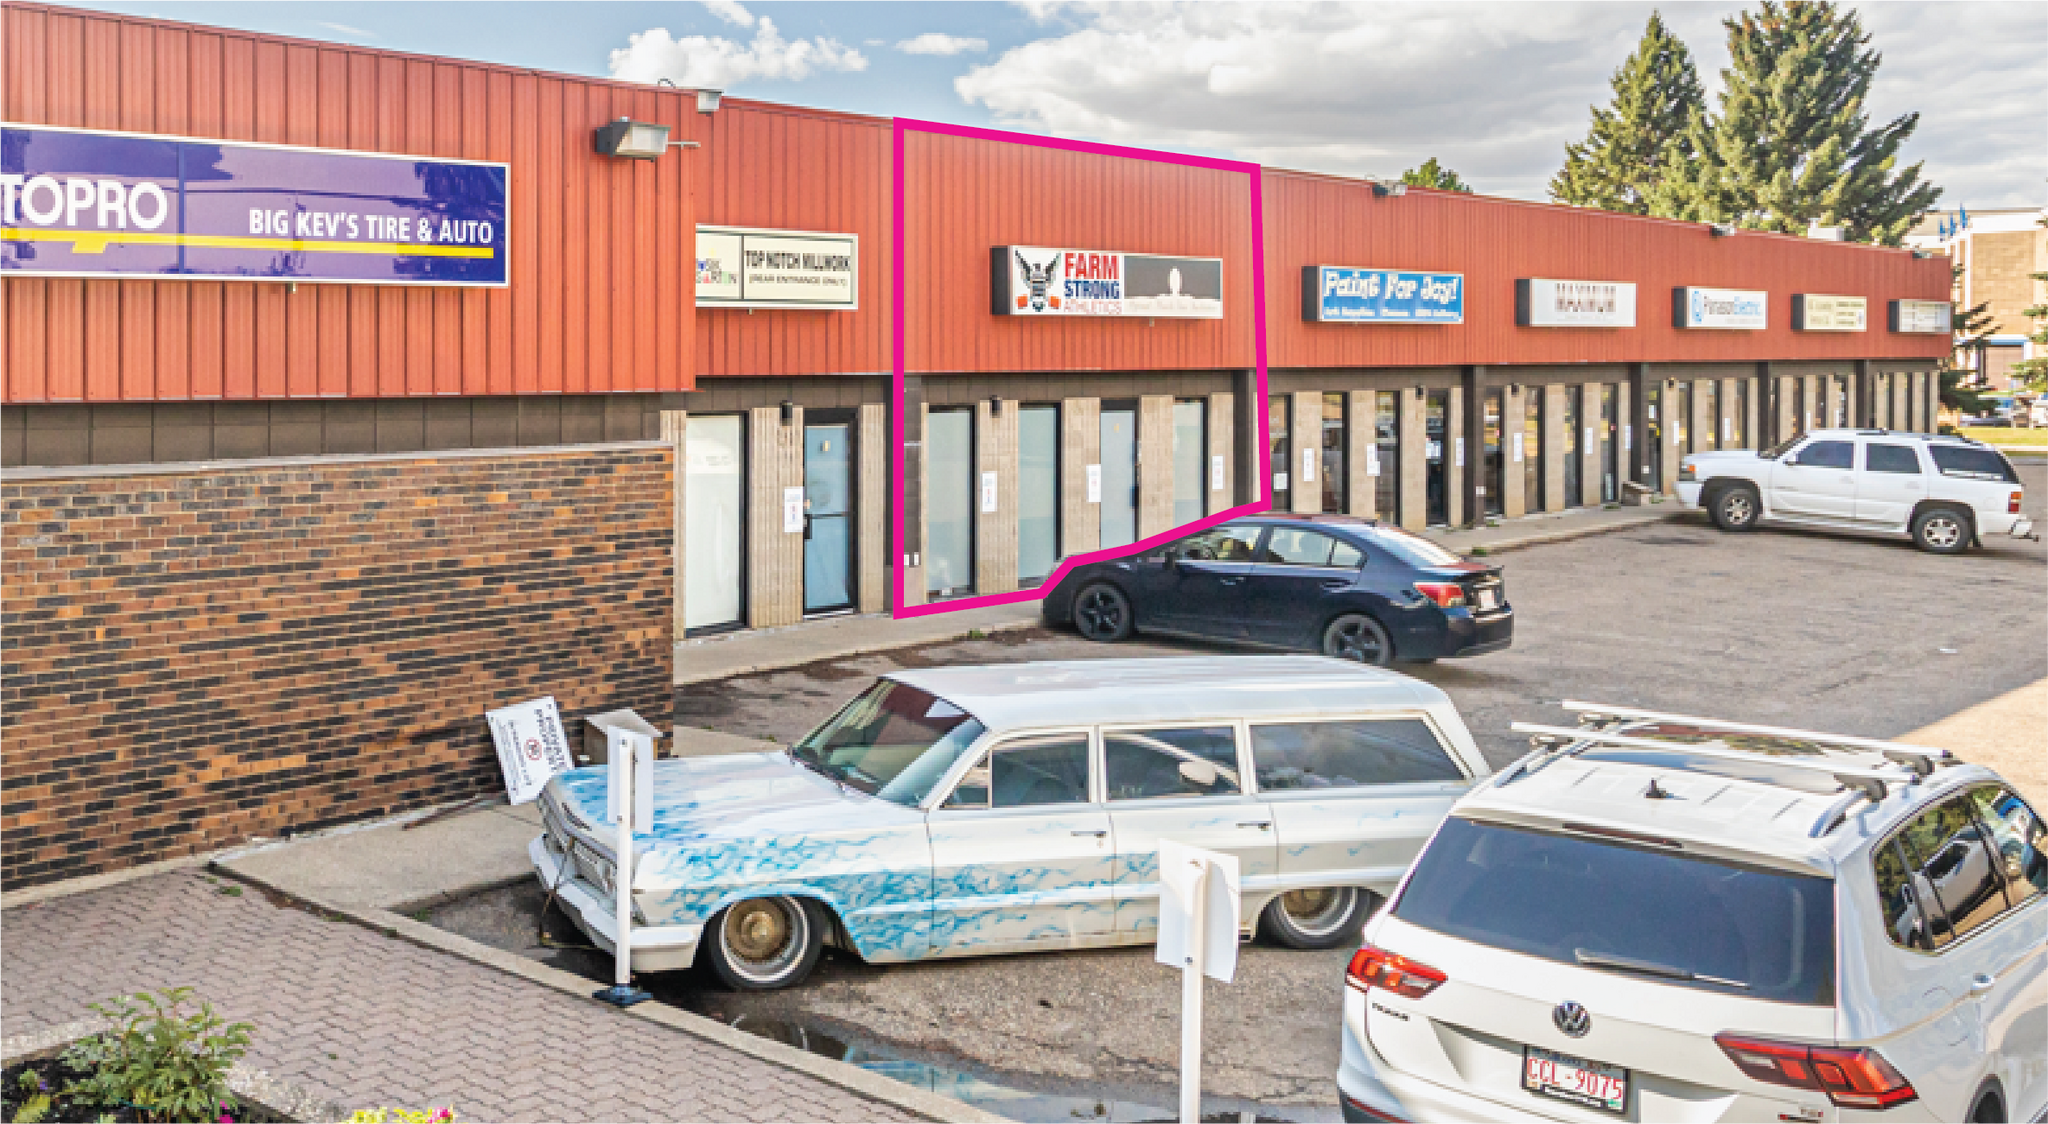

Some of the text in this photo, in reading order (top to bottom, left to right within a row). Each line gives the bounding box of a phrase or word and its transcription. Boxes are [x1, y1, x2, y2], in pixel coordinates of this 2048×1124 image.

[249, 208, 494, 244] BIG KEV'S TIRE & AUTO
[745, 250, 851, 272] TOP NOTCH MILLWORK
[1064, 253, 1120, 280] FARM
[1064, 279, 1120, 298] STRONG
[1324, 270, 1380, 299] Paint
[1064, 299, 1122, 314] ATHLETICS
